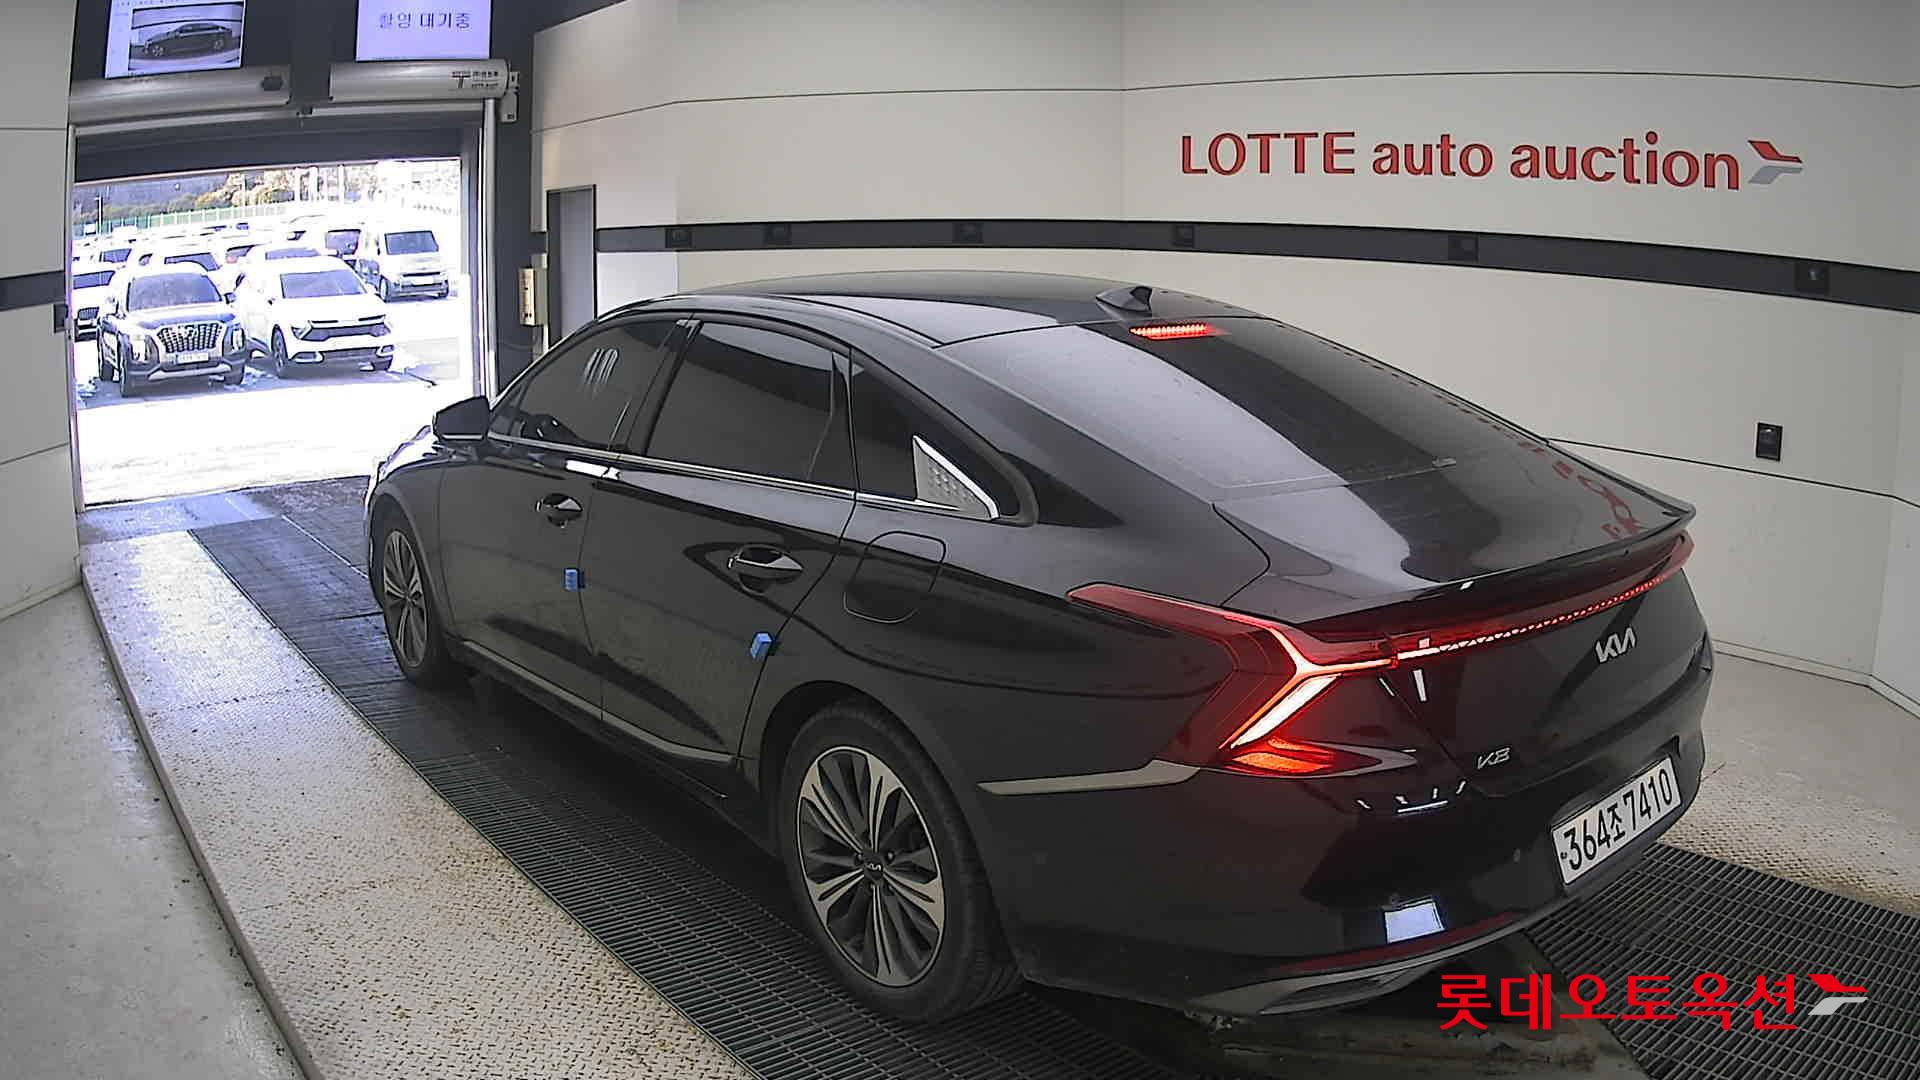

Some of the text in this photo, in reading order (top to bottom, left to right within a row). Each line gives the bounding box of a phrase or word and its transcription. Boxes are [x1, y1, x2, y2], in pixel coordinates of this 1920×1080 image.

[420, 12, 470, 29] 대기중
[1182, 131, 1740, 191] LOTTE auto auction
[1595, 627, 1637, 663] KIA
[1476, 747, 1511, 770] K8
[1563, 768, 1673, 871] 364조 7410
